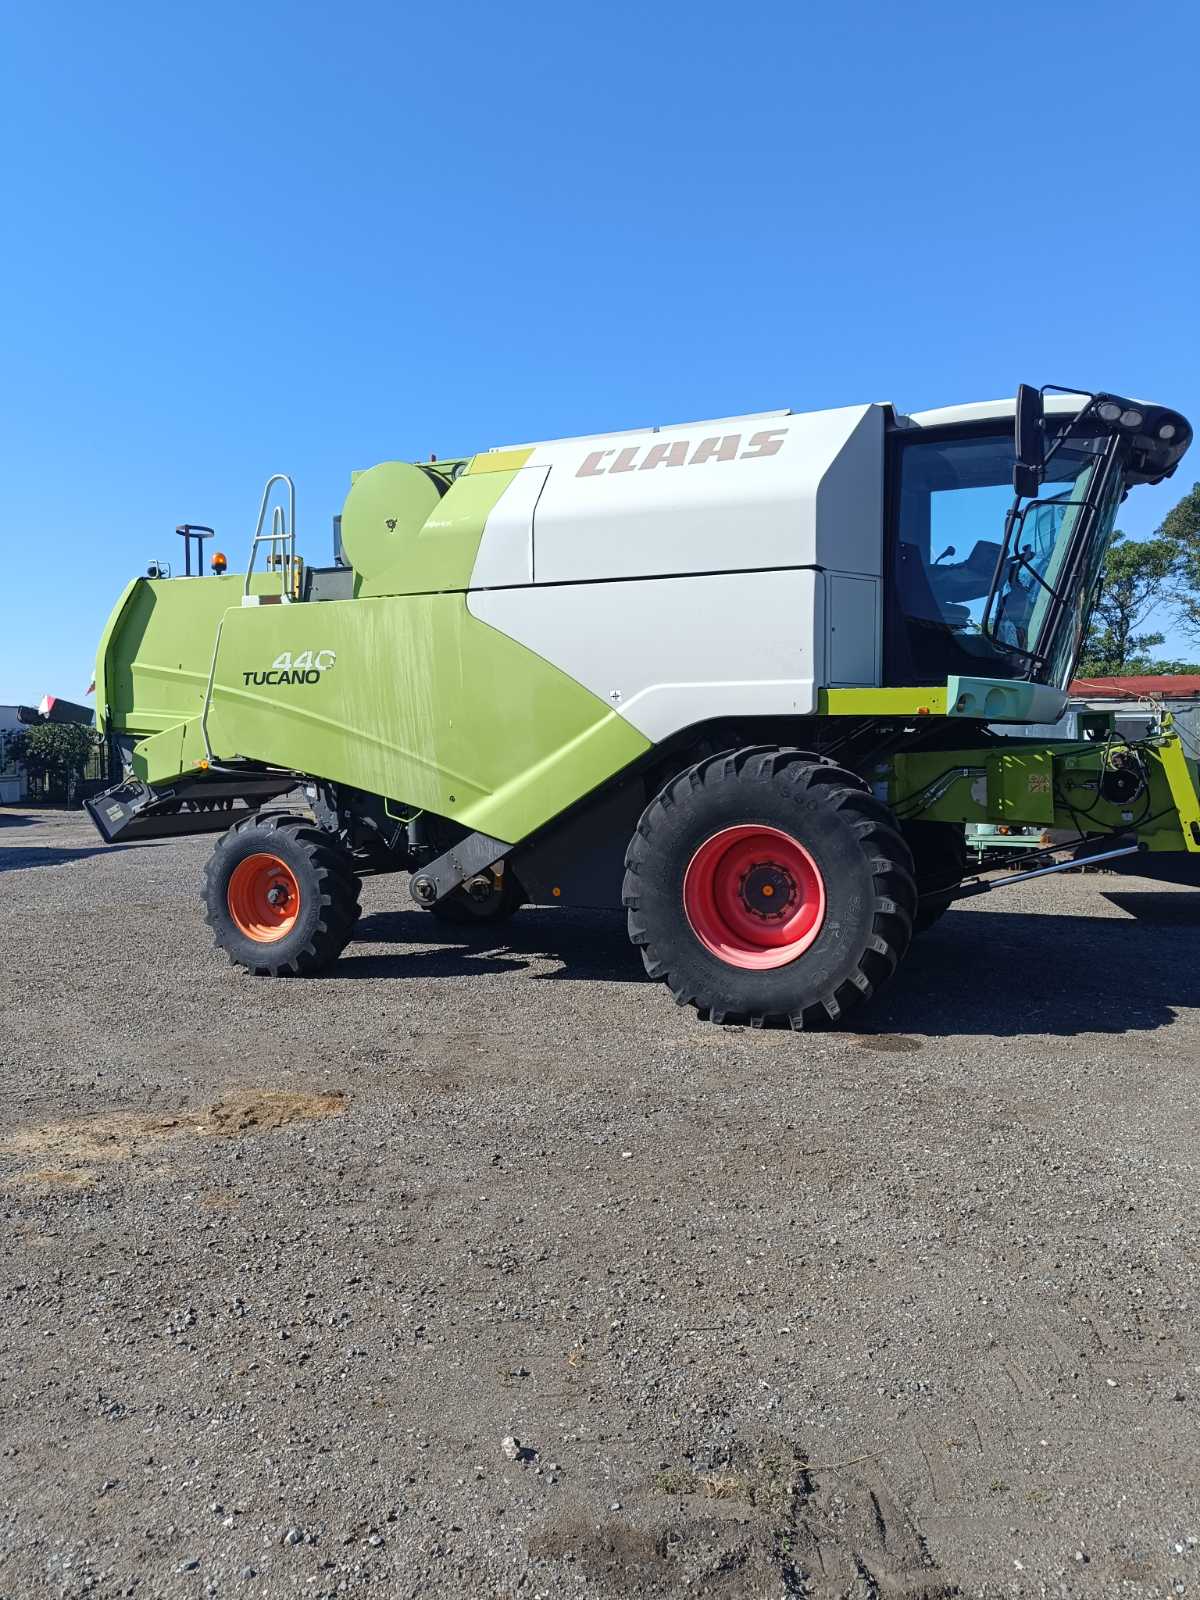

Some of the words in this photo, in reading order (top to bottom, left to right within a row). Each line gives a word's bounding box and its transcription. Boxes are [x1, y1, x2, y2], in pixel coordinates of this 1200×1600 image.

[575, 428, 789, 477] CLAAS
[272, 649, 336, 671] 440
[243, 670, 320, 686] TUCANO
